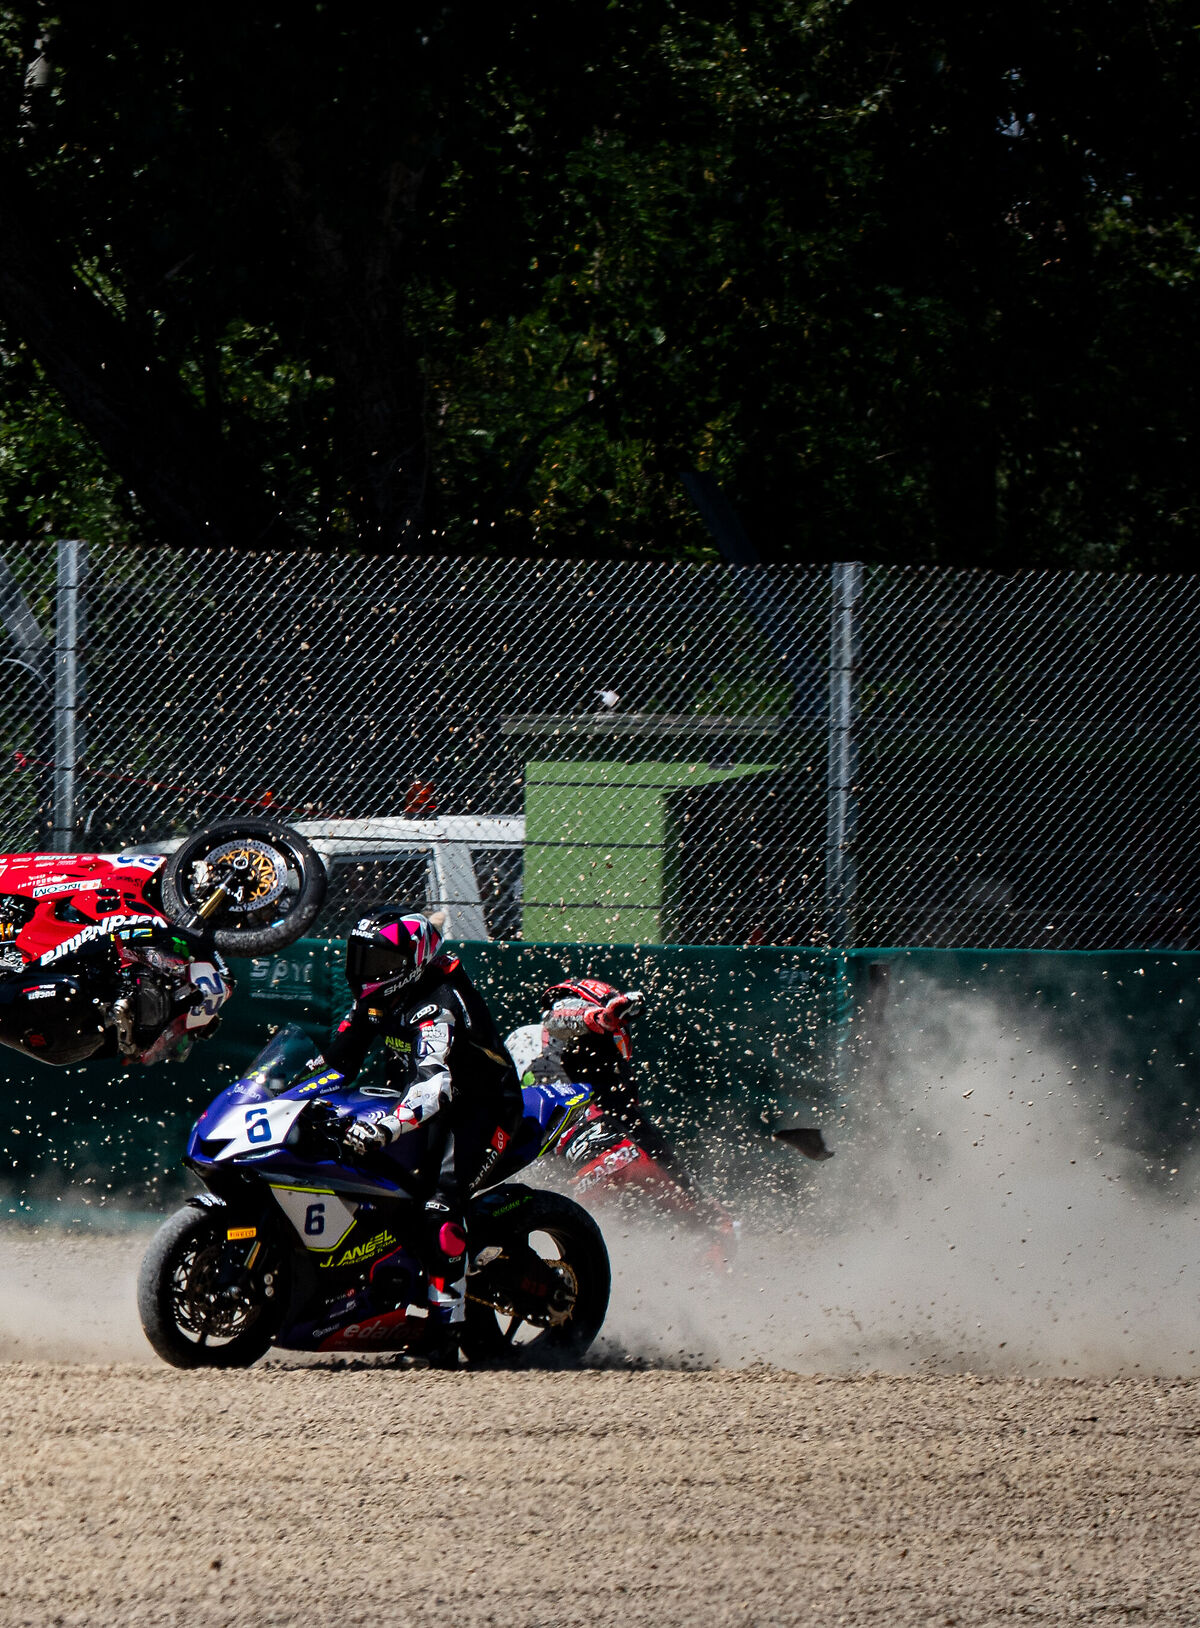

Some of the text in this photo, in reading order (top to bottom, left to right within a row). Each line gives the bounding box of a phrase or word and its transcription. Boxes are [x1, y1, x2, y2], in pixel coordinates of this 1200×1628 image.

[383, 968, 424, 997] SHARK
[245, 1108, 272, 1144] 6
[305, 1203, 326, 1235] 6
[337, 1229, 393, 1267] ANGEL
